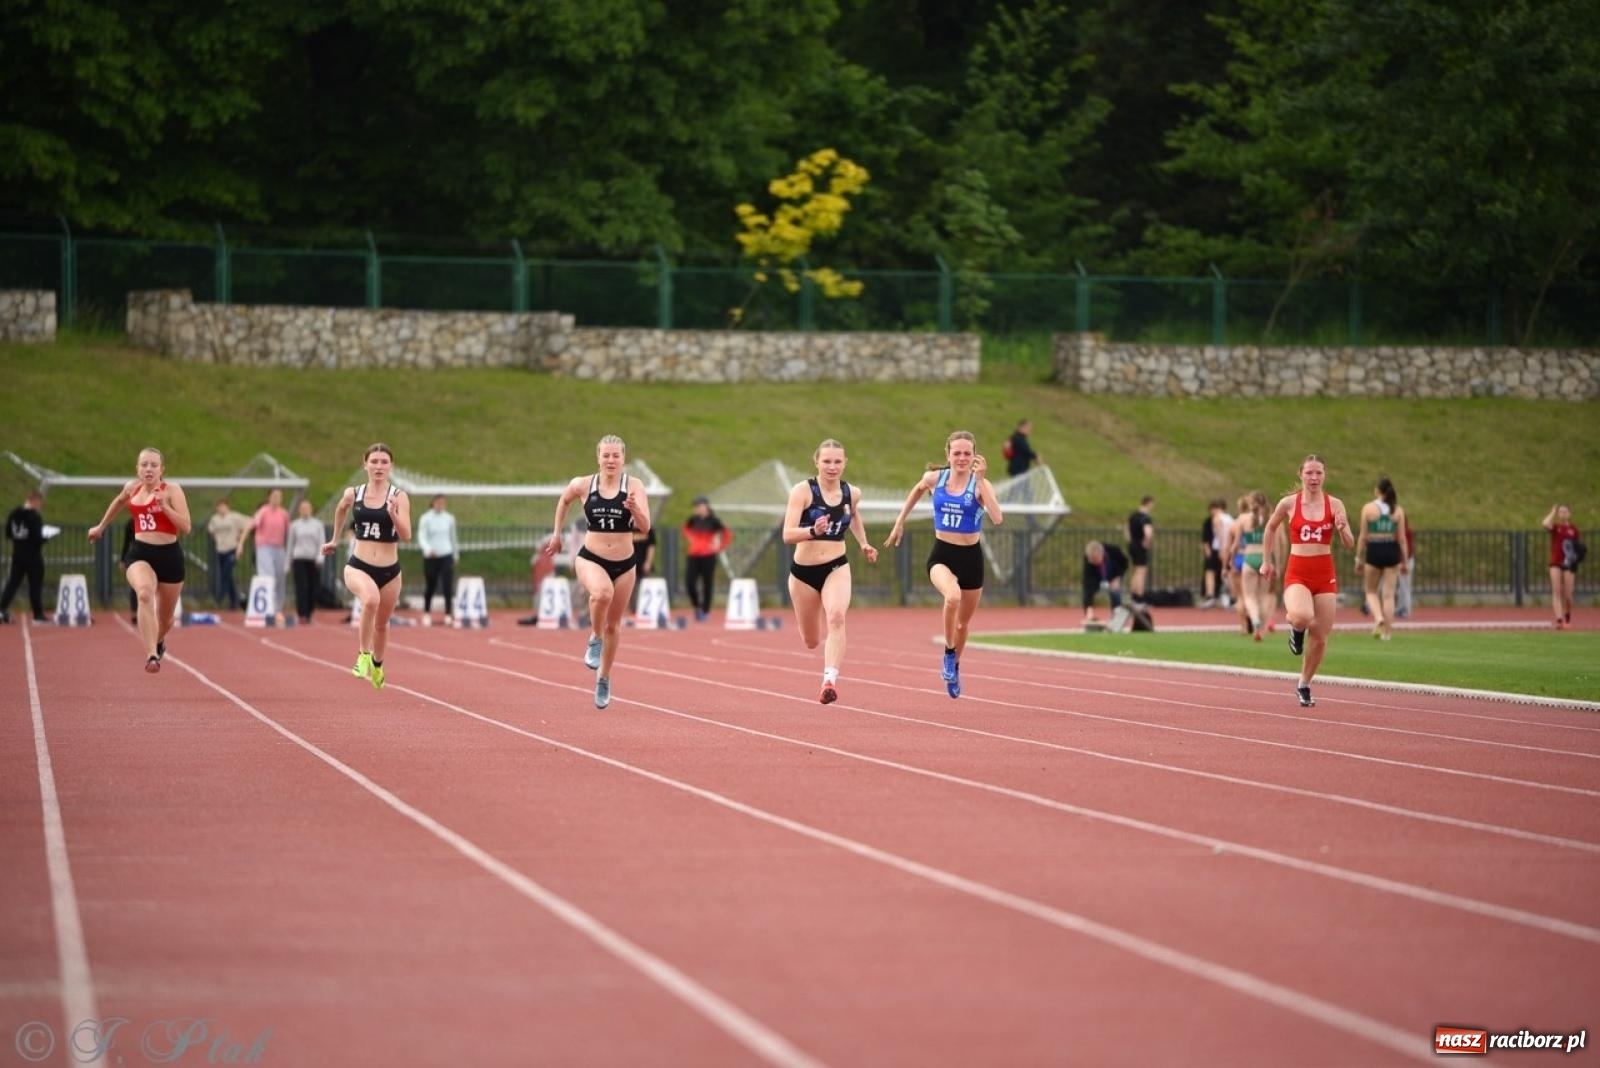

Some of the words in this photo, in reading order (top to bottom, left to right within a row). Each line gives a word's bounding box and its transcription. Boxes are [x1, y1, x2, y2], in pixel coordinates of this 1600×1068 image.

[138, 513, 157, 531] 63
[598, 518, 616, 530] 11
[942, 513, 962, 528] 417
[361, 521, 381, 539] 74
[254, 585, 267, 613] 6
